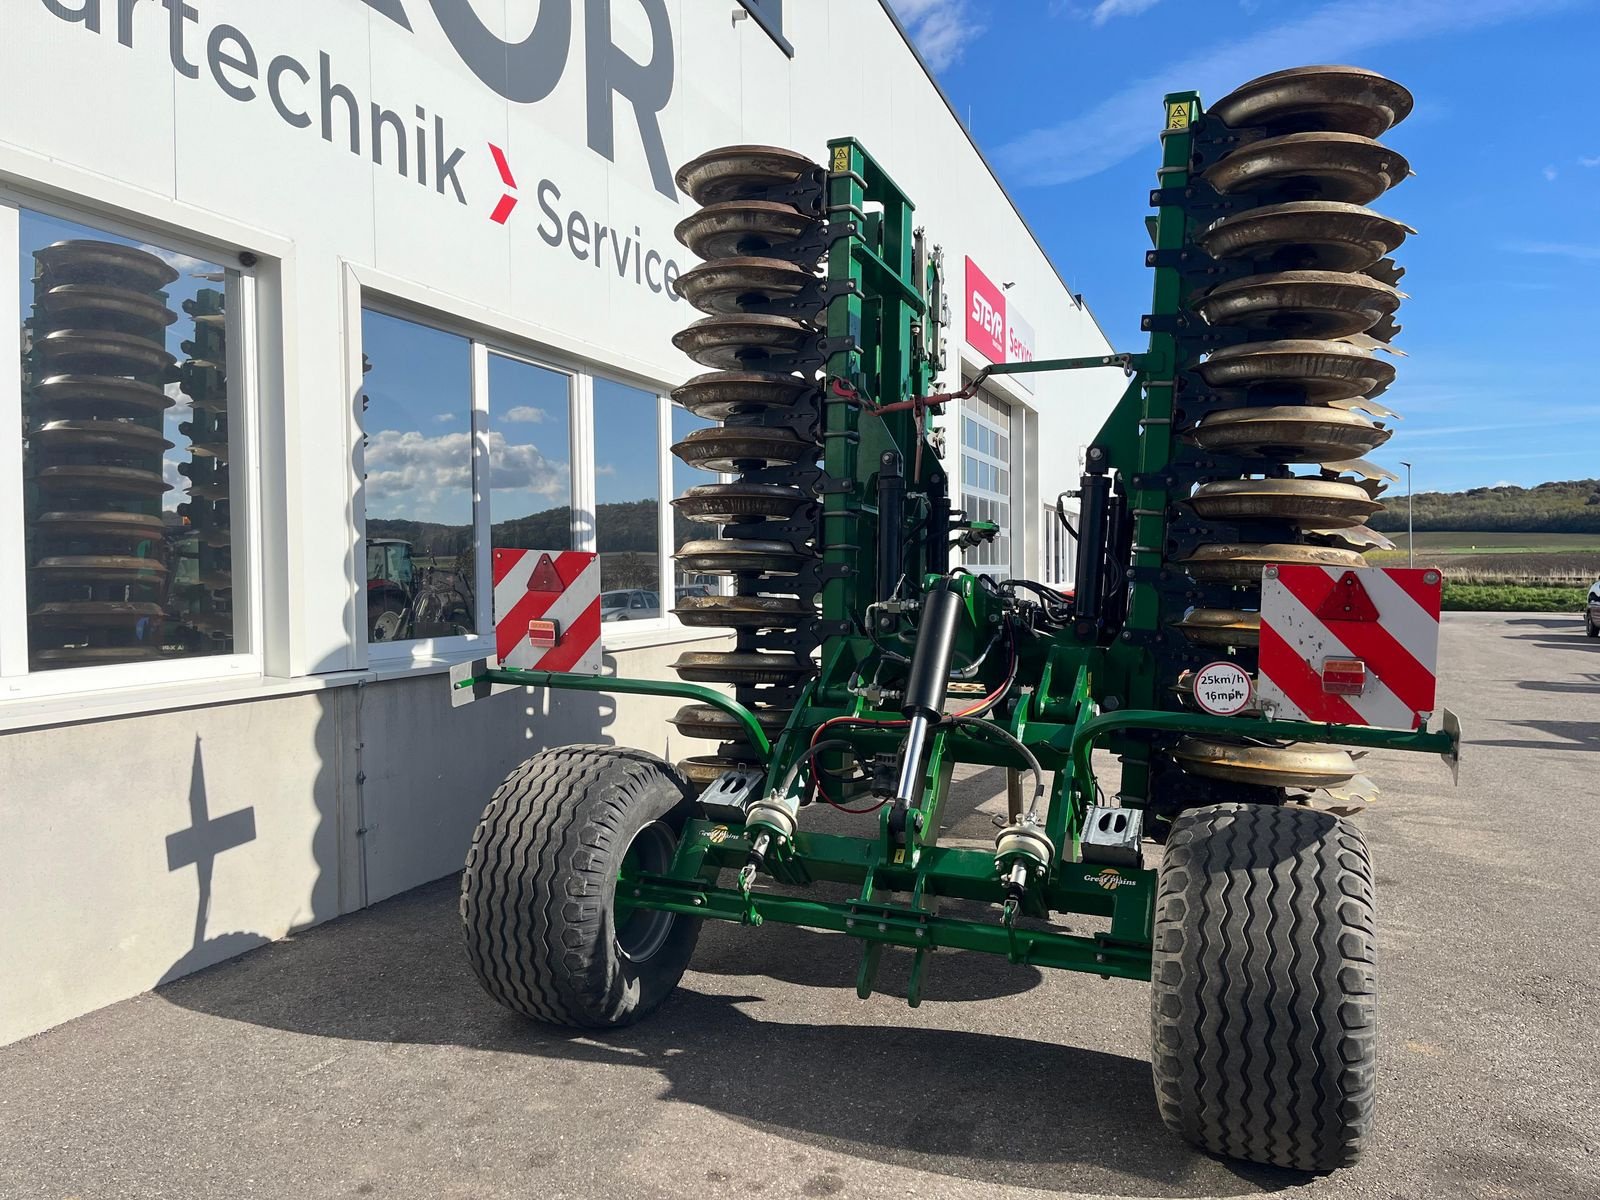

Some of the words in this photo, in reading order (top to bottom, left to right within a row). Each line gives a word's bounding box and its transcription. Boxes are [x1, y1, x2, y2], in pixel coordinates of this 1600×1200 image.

[360, 0, 679, 204] OR
[537, 179, 680, 302] Service
[972, 290, 1003, 344] STEYR
[1201, 674, 1244, 685] 25km/h
[1205, 690, 1244, 702] 16mph
[1083, 874, 1108, 883] Great
[1110, 875, 1136, 886] Plains
